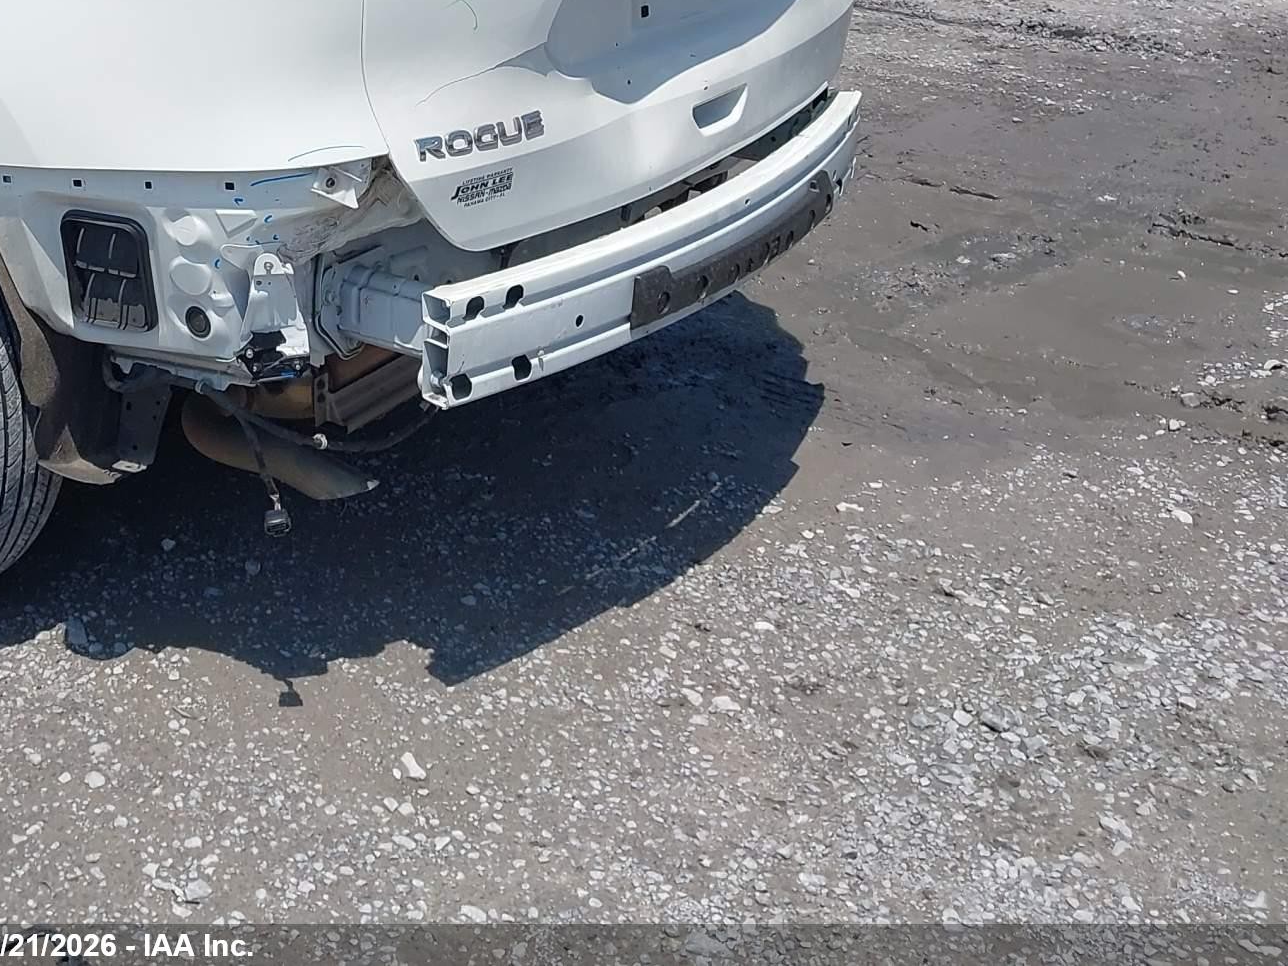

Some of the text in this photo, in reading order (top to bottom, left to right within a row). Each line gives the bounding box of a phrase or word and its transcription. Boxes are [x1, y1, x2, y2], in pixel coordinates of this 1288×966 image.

[413, 109, 545, 162] ROGUE
[451, 173, 513, 200] JOHN LEE
